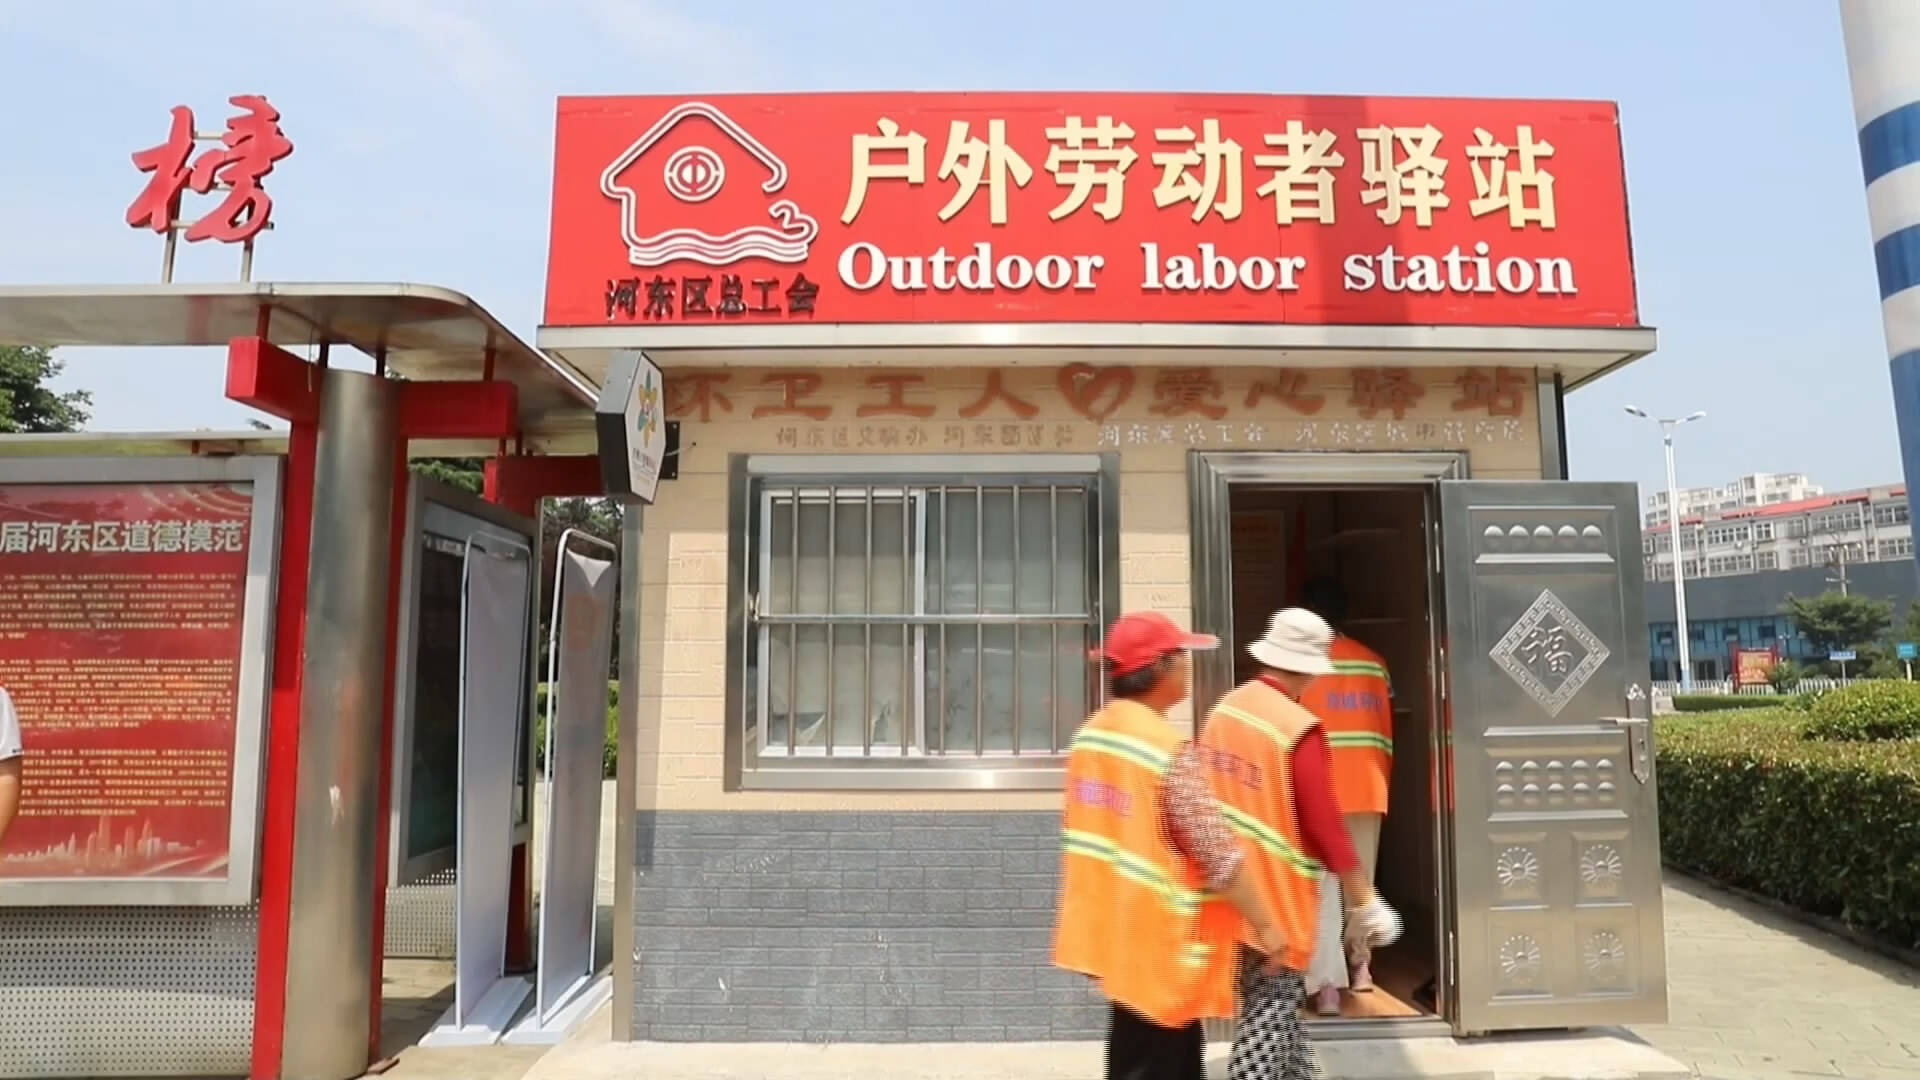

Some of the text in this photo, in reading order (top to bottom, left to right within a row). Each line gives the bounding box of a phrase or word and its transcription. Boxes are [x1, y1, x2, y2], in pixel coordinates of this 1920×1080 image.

[840, 115, 1556, 229] 户外劳动者驿站
[837, 241, 1578, 295] Outdoor labor station
[604, 272, 820, 320] 河东区总工会
[1148, 366, 1527, 420] 爱心驿站
[0, 520, 245, 554] 届河东区道德模范
